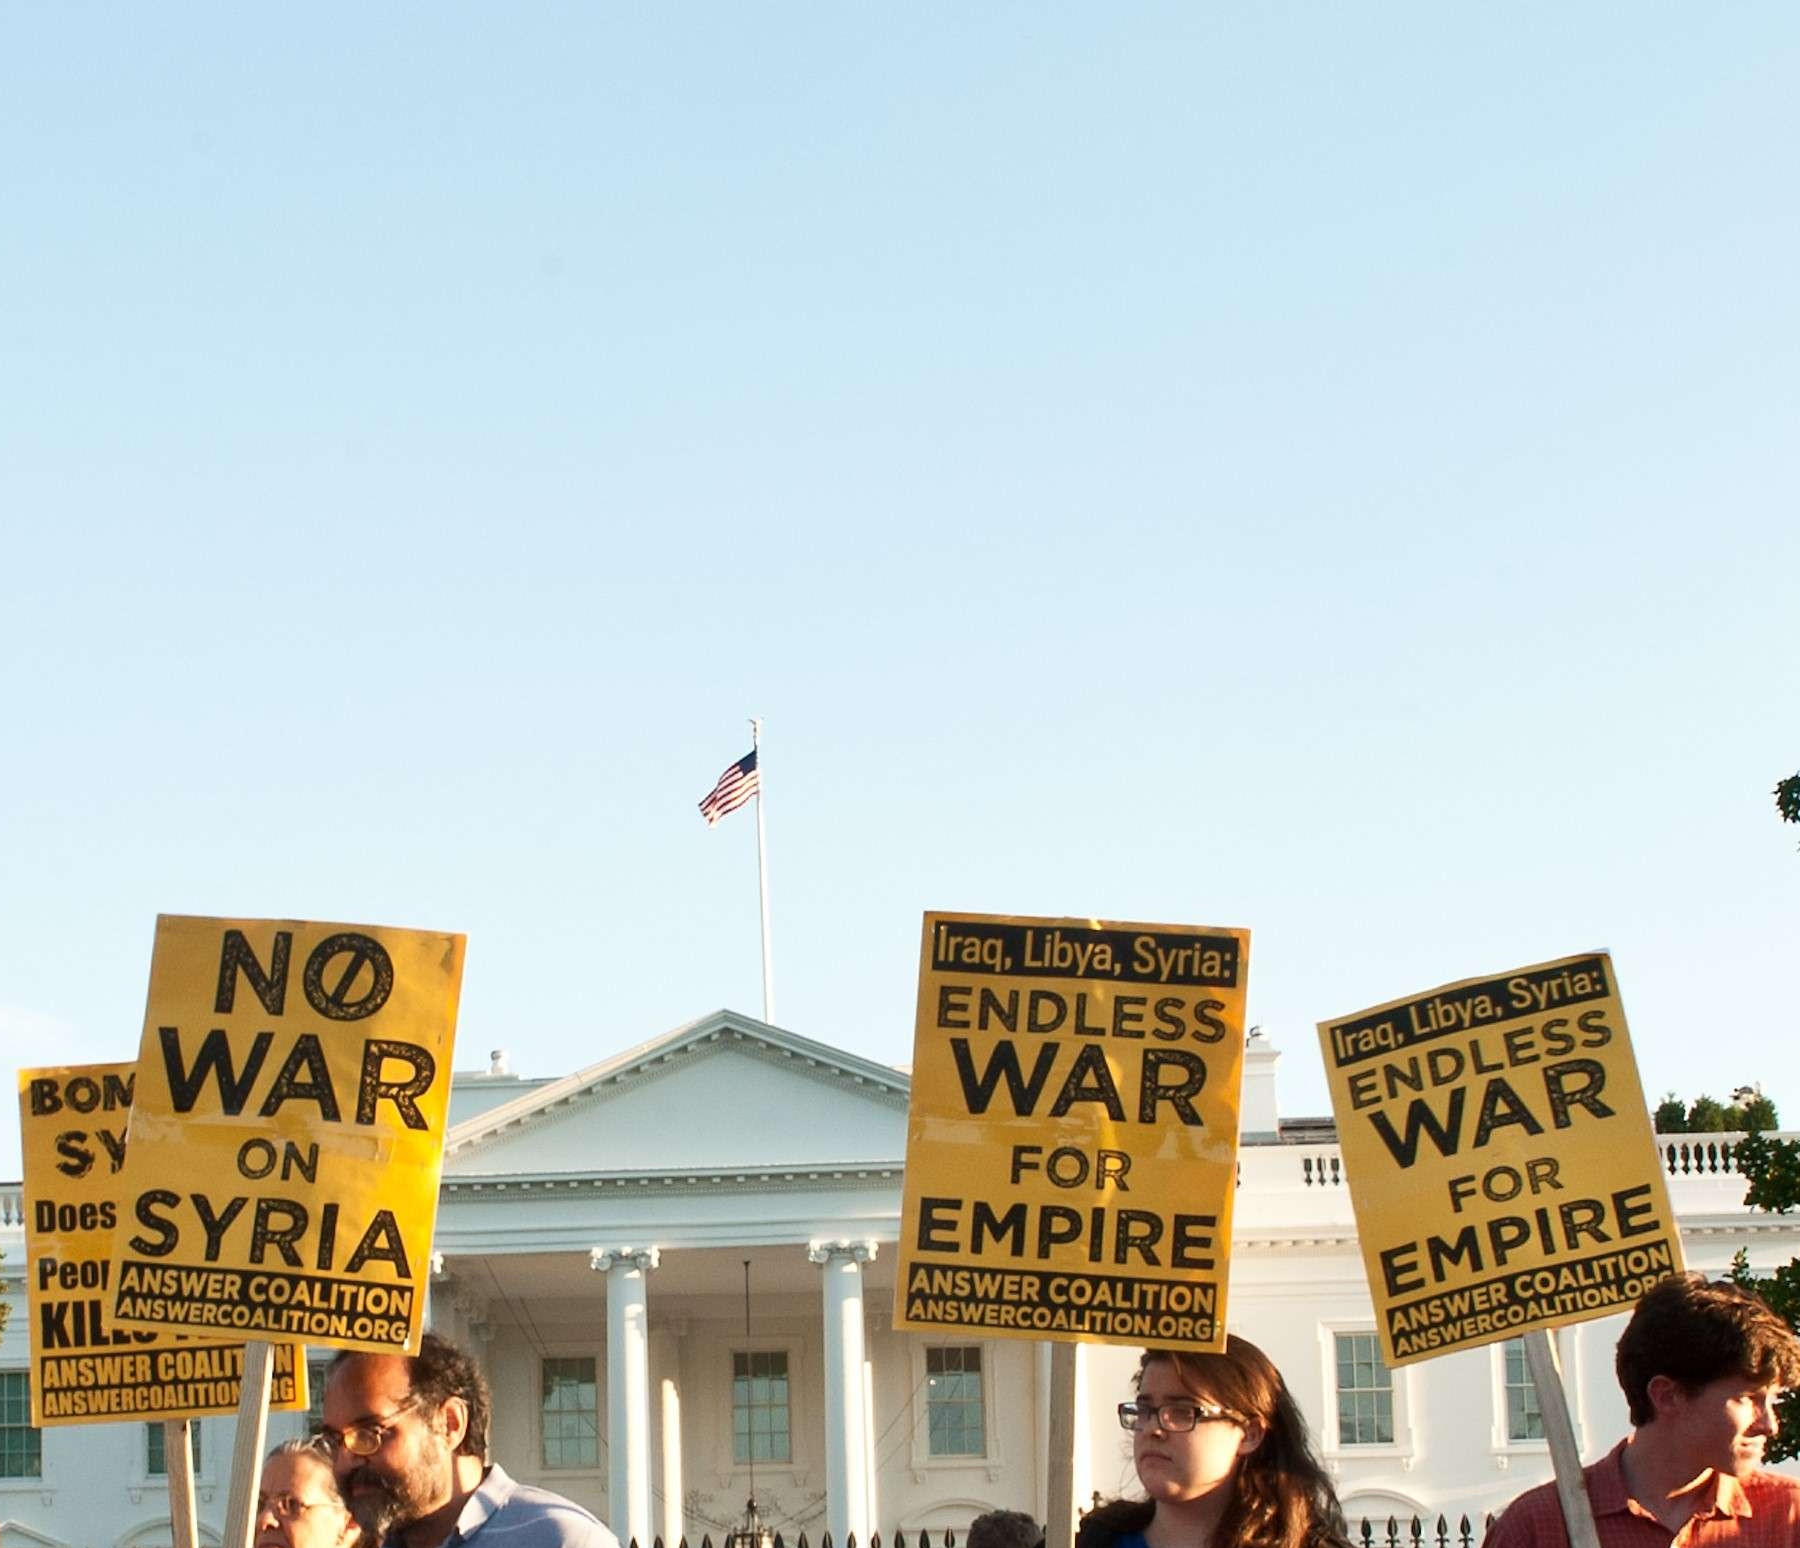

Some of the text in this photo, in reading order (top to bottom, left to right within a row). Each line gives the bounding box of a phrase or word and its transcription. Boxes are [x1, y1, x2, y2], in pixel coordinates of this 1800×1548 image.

[214, 930, 394, 1022] NO
[937, 924, 1231, 982] Iraq, Libya, Syria:
[937, 985, 1225, 1043] ENDLESS
[1334, 970, 1602, 1059] Iraq, Libya, Syria:
[158, 1026, 436, 1132] WAR
[950, 1037, 1207, 1127] WAR
[1347, 1010, 1612, 1110] ENDLESS
[1368, 1058, 1615, 1169] WAR
[237, 1137, 319, 1184] ON
[1010, 1146, 1131, 1191] FOR
[1448, 1156, 1563, 1213] FOR
[36, 1200, 117, 1233] Does
[129, 1189, 412, 1279] SYRIA
[917, 1196, 1217, 1270] EMPIRE
[1379, 1183, 1661, 1298] EMPIRE
[121, 1267, 411, 1316] ANSWER COALITION
[910, 1268, 1214, 1314] ANSWER COALITION
[1391, 1244, 1672, 1334] ANSWER COALITION
[117, 1297, 407, 1342] ANSWERCOALITION.ORG
[908, 1303, 1211, 1340] ANSWERCOALITION.ORG
[43, 1345, 292, 1388] ANSWER COALITN
